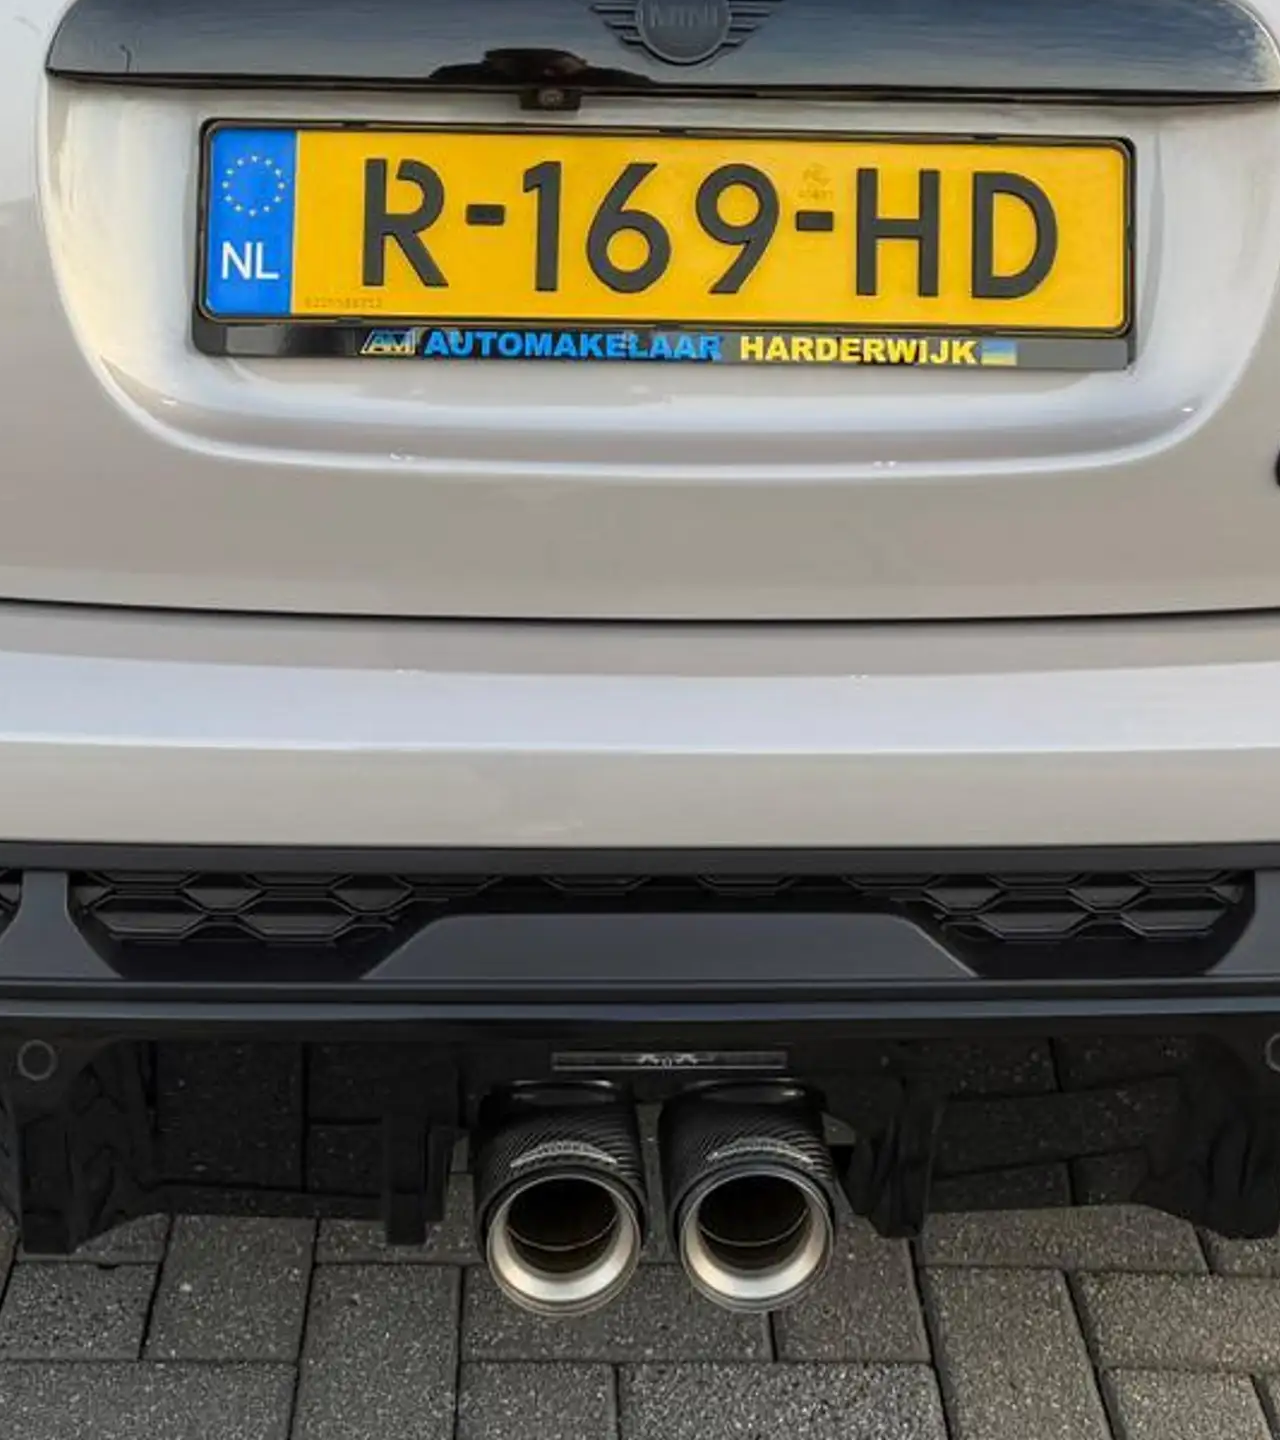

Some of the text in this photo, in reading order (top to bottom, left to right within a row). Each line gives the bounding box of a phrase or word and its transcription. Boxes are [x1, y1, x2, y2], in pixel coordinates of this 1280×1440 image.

[649, 0, 718, 29] MINI
[361, 158, 1058, 299] R-169-HD
[221, 241, 280, 280] NL
[424, 330, 722, 360] AUTOMAKELAAR
[740, 335, 977, 365] HARDERWIJK
